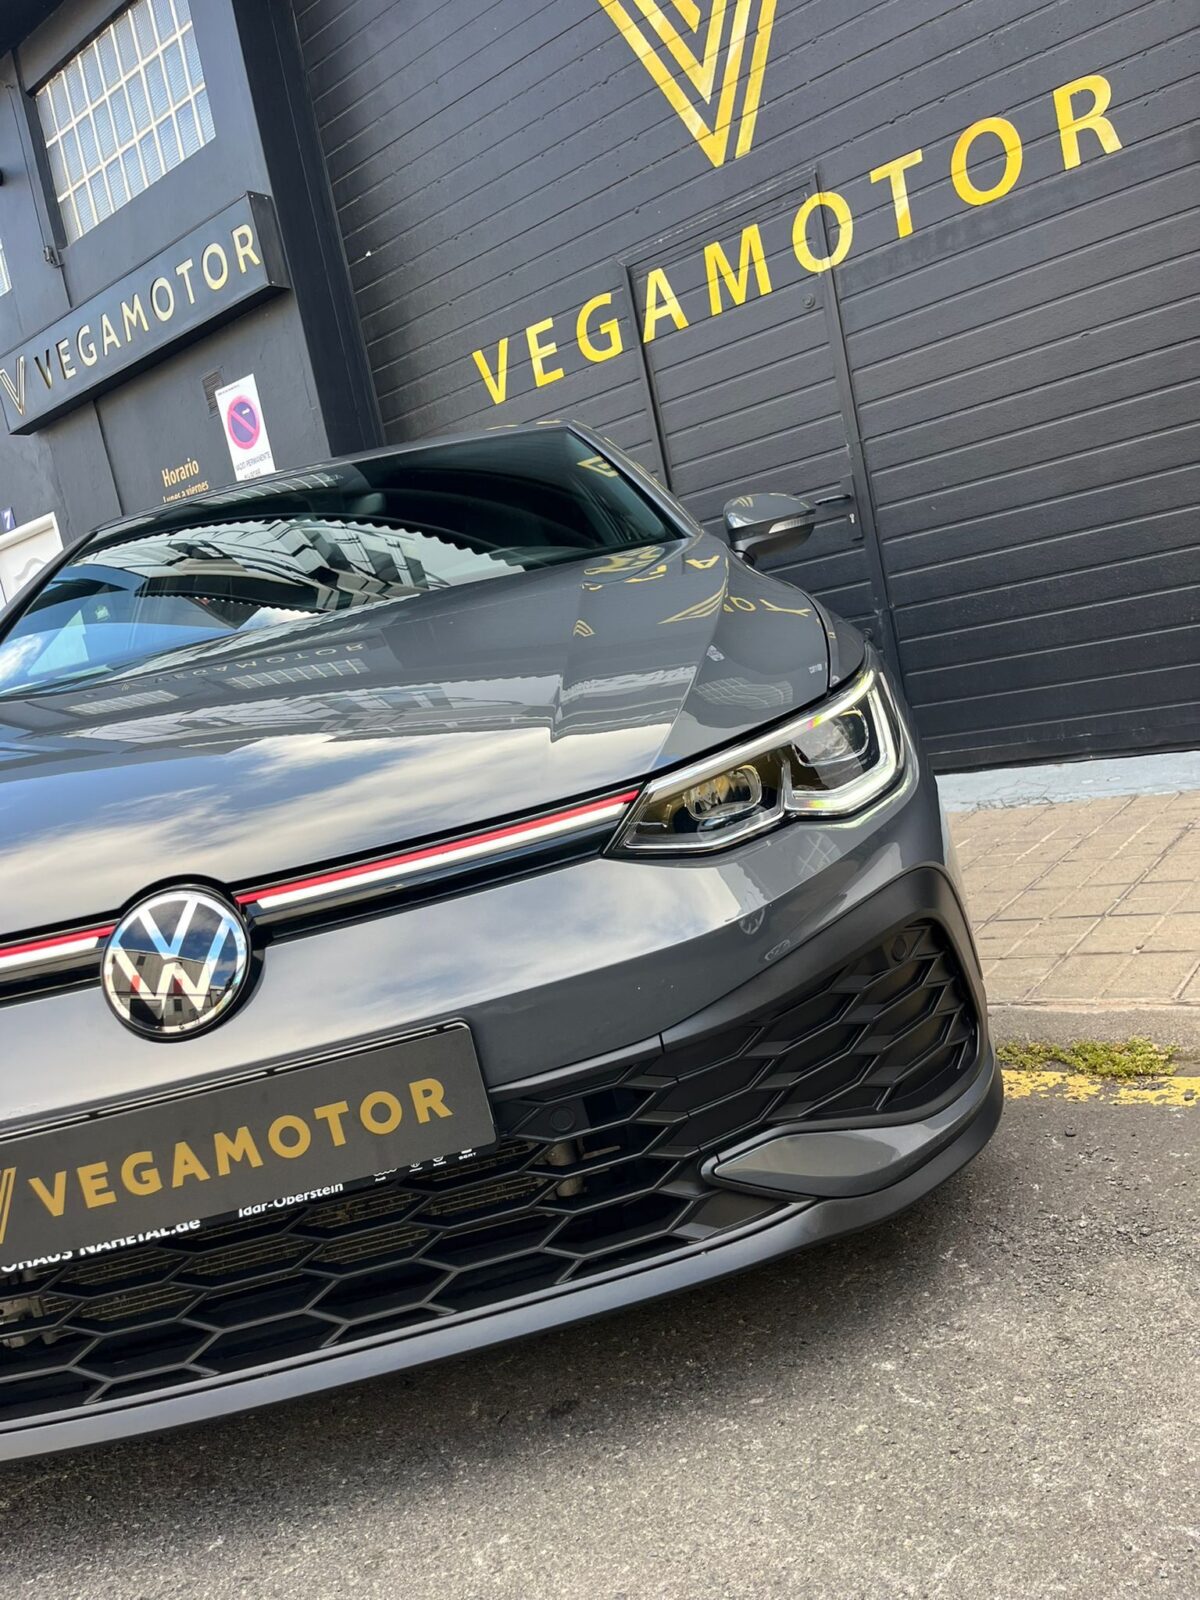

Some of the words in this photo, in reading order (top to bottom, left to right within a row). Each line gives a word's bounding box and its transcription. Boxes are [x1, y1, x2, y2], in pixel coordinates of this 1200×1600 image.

[34, 224, 261, 390] VEGAMOTOR
[472, 74, 1122, 405] VEGAMOTOR
[161, 457, 199, 488] Horario
[186, 480, 209, 496] viernes
[29, 1077, 454, 1217] VEGAMOTOR
